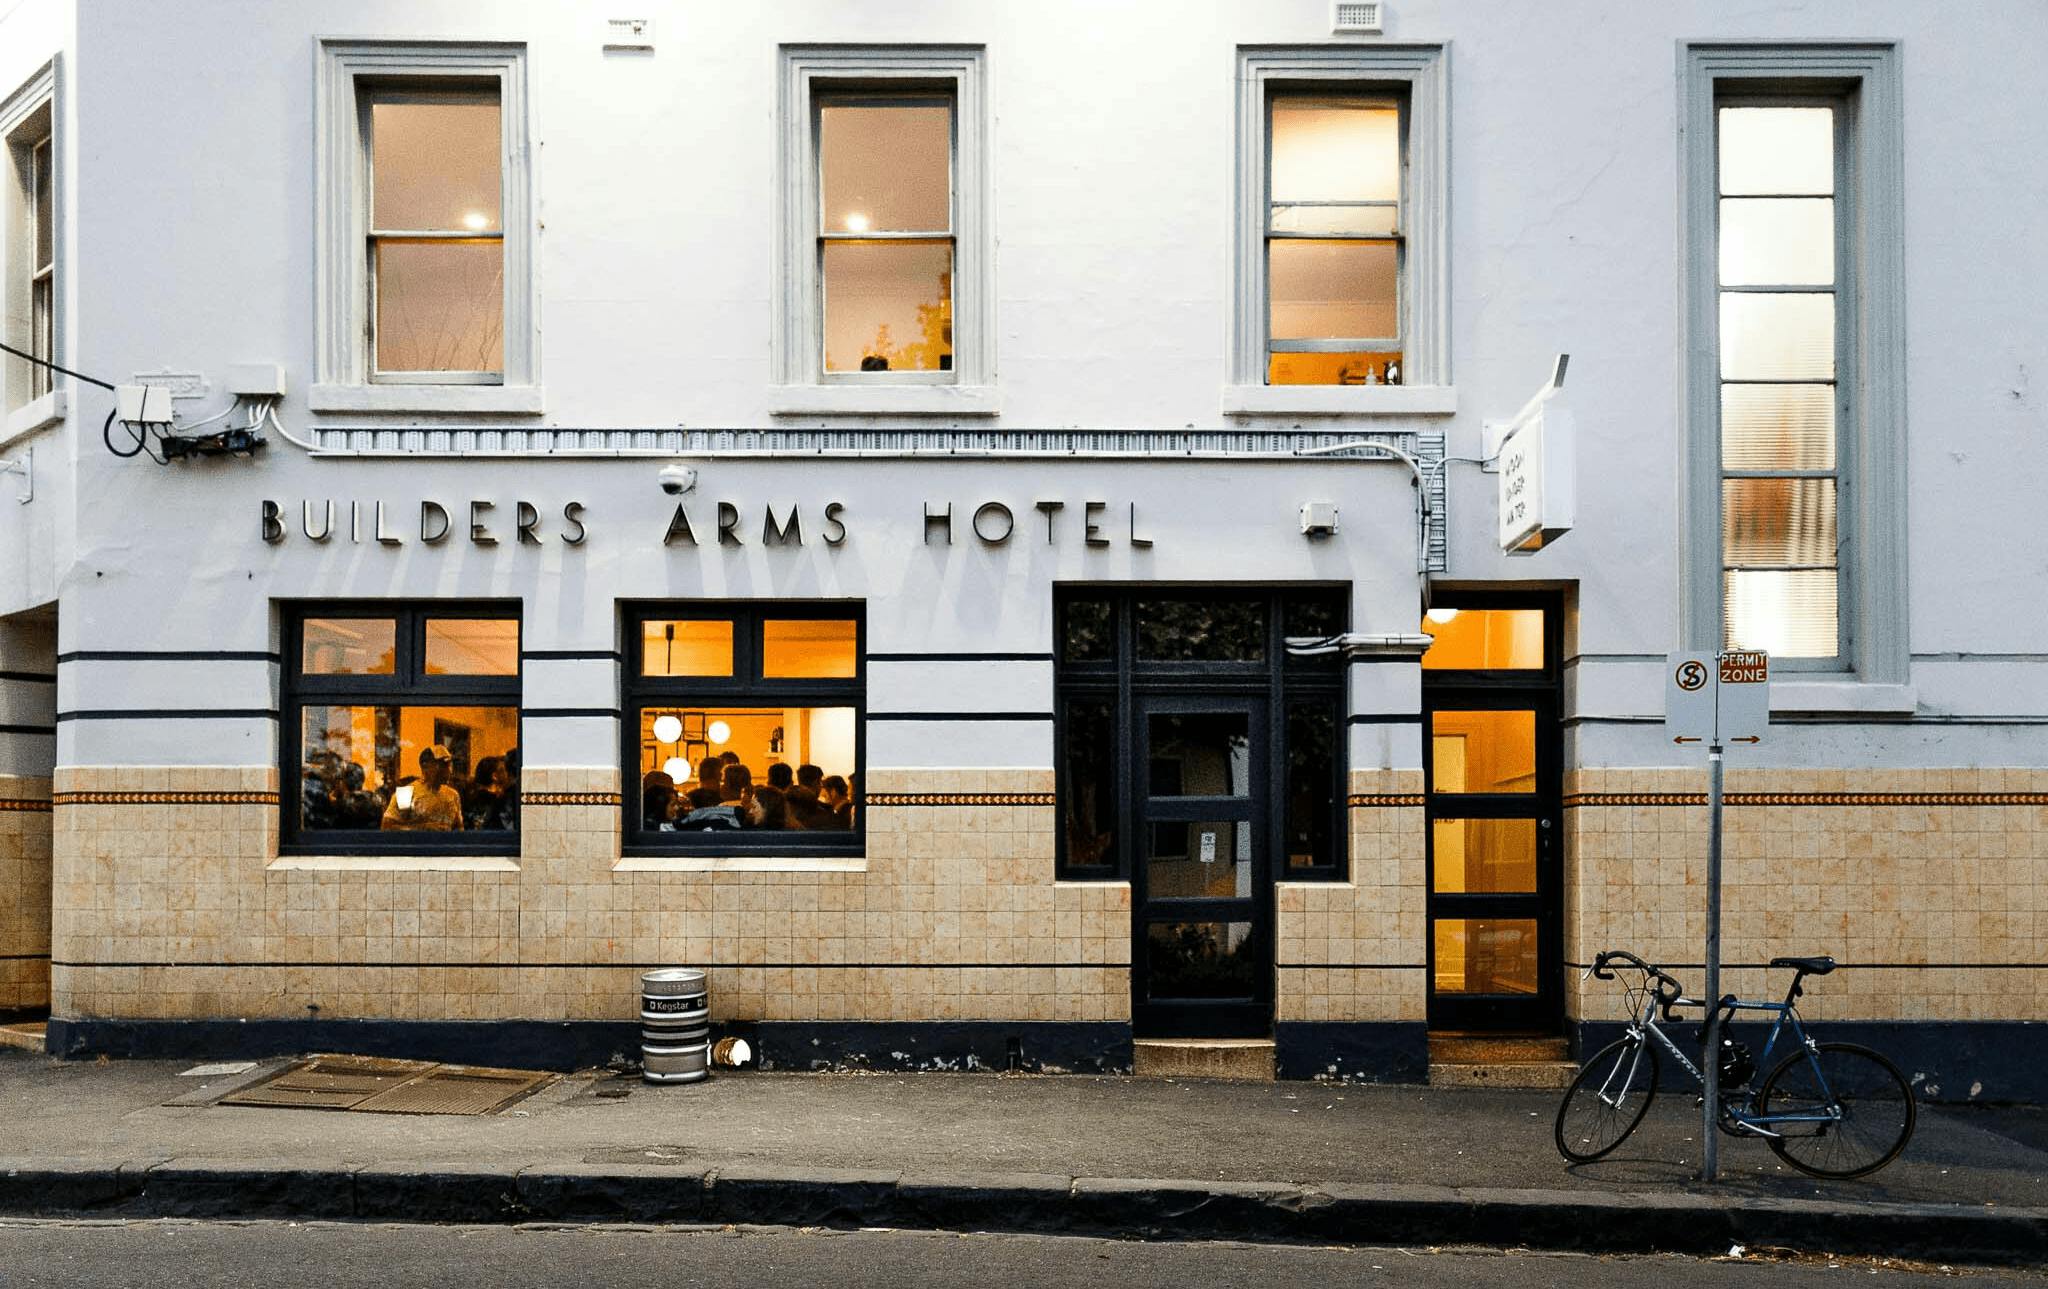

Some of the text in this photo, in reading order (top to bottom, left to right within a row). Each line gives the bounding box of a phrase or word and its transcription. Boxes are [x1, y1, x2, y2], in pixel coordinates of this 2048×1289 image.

[262, 499, 1154, 547] BUILDERS ARMS HOTEL
[1721, 653, 1767, 667] PERMIT
[1720, 669, 1766, 682] ZONE
[657, 1001, 689, 1013] Kegstar
